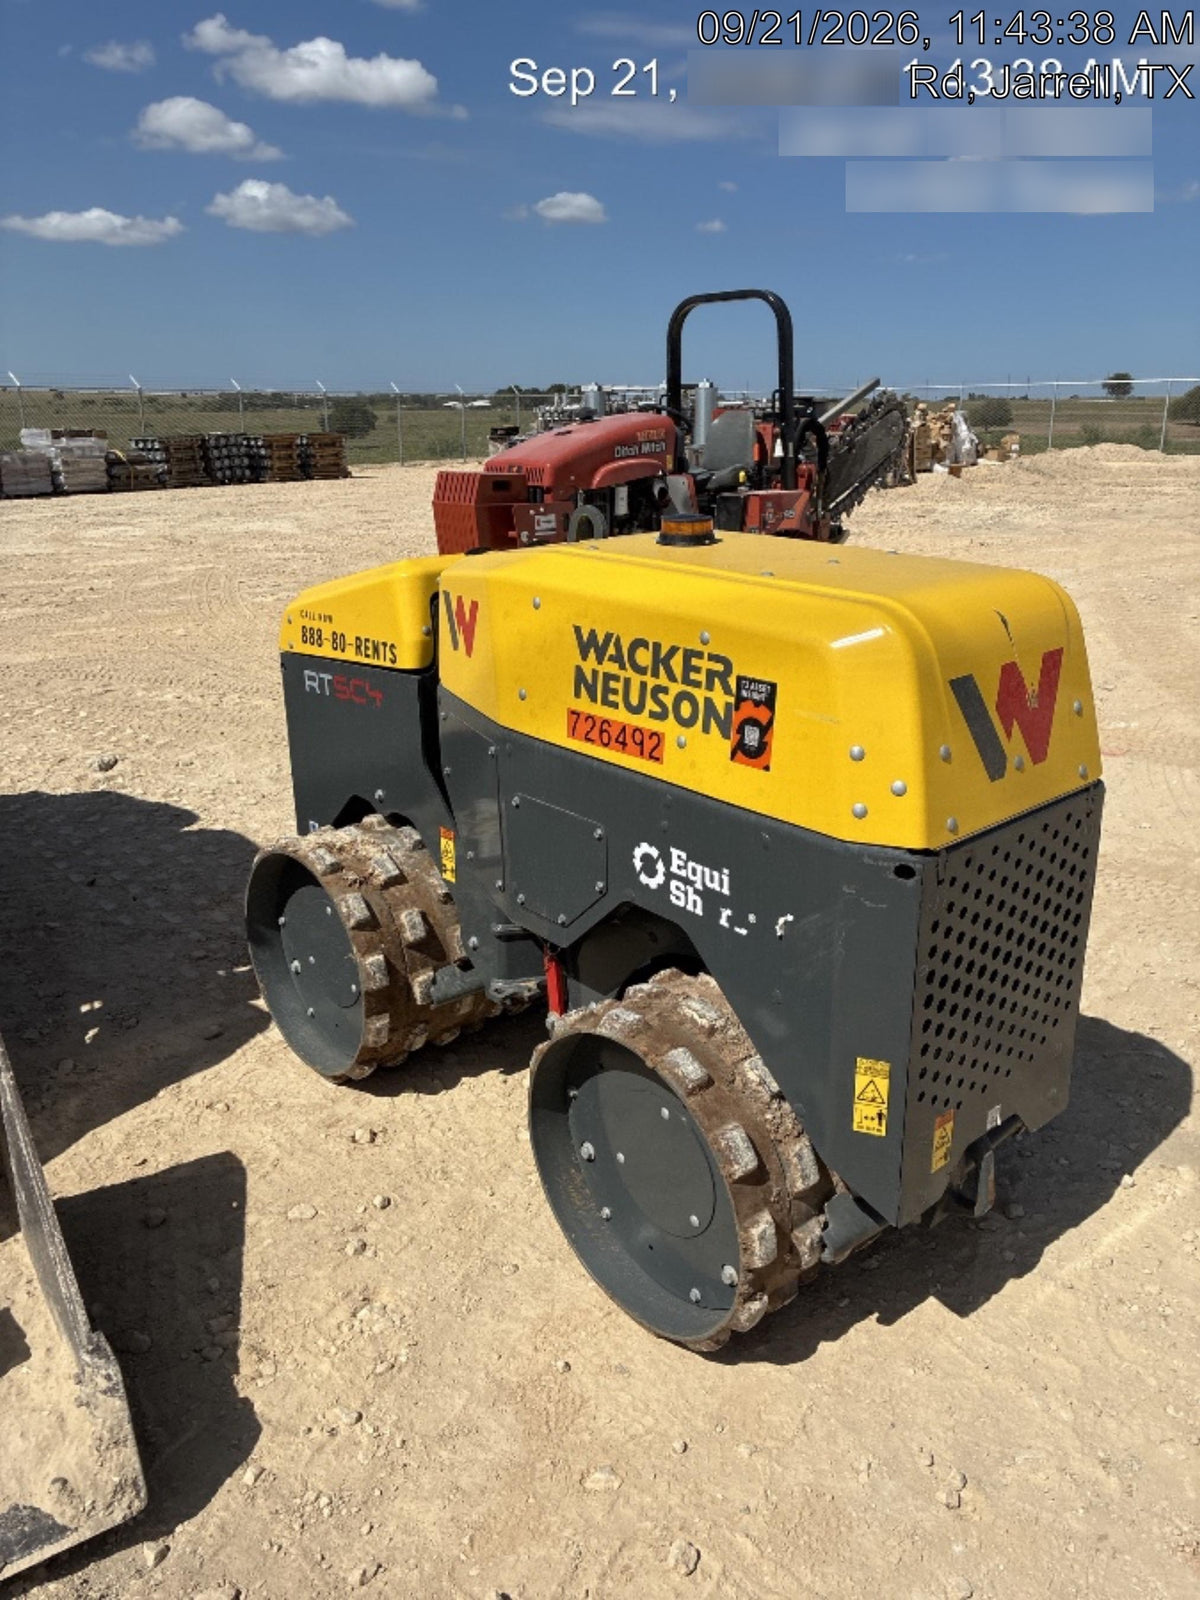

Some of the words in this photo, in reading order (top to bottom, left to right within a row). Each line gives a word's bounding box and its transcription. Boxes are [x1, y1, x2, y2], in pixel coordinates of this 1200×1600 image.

[301, 625, 398, 665] 888-80-RENTS
[572, 624, 735, 696] WACKER
[573, 664, 734, 741] NEUSON
[569, 710, 662, 762] 726492
